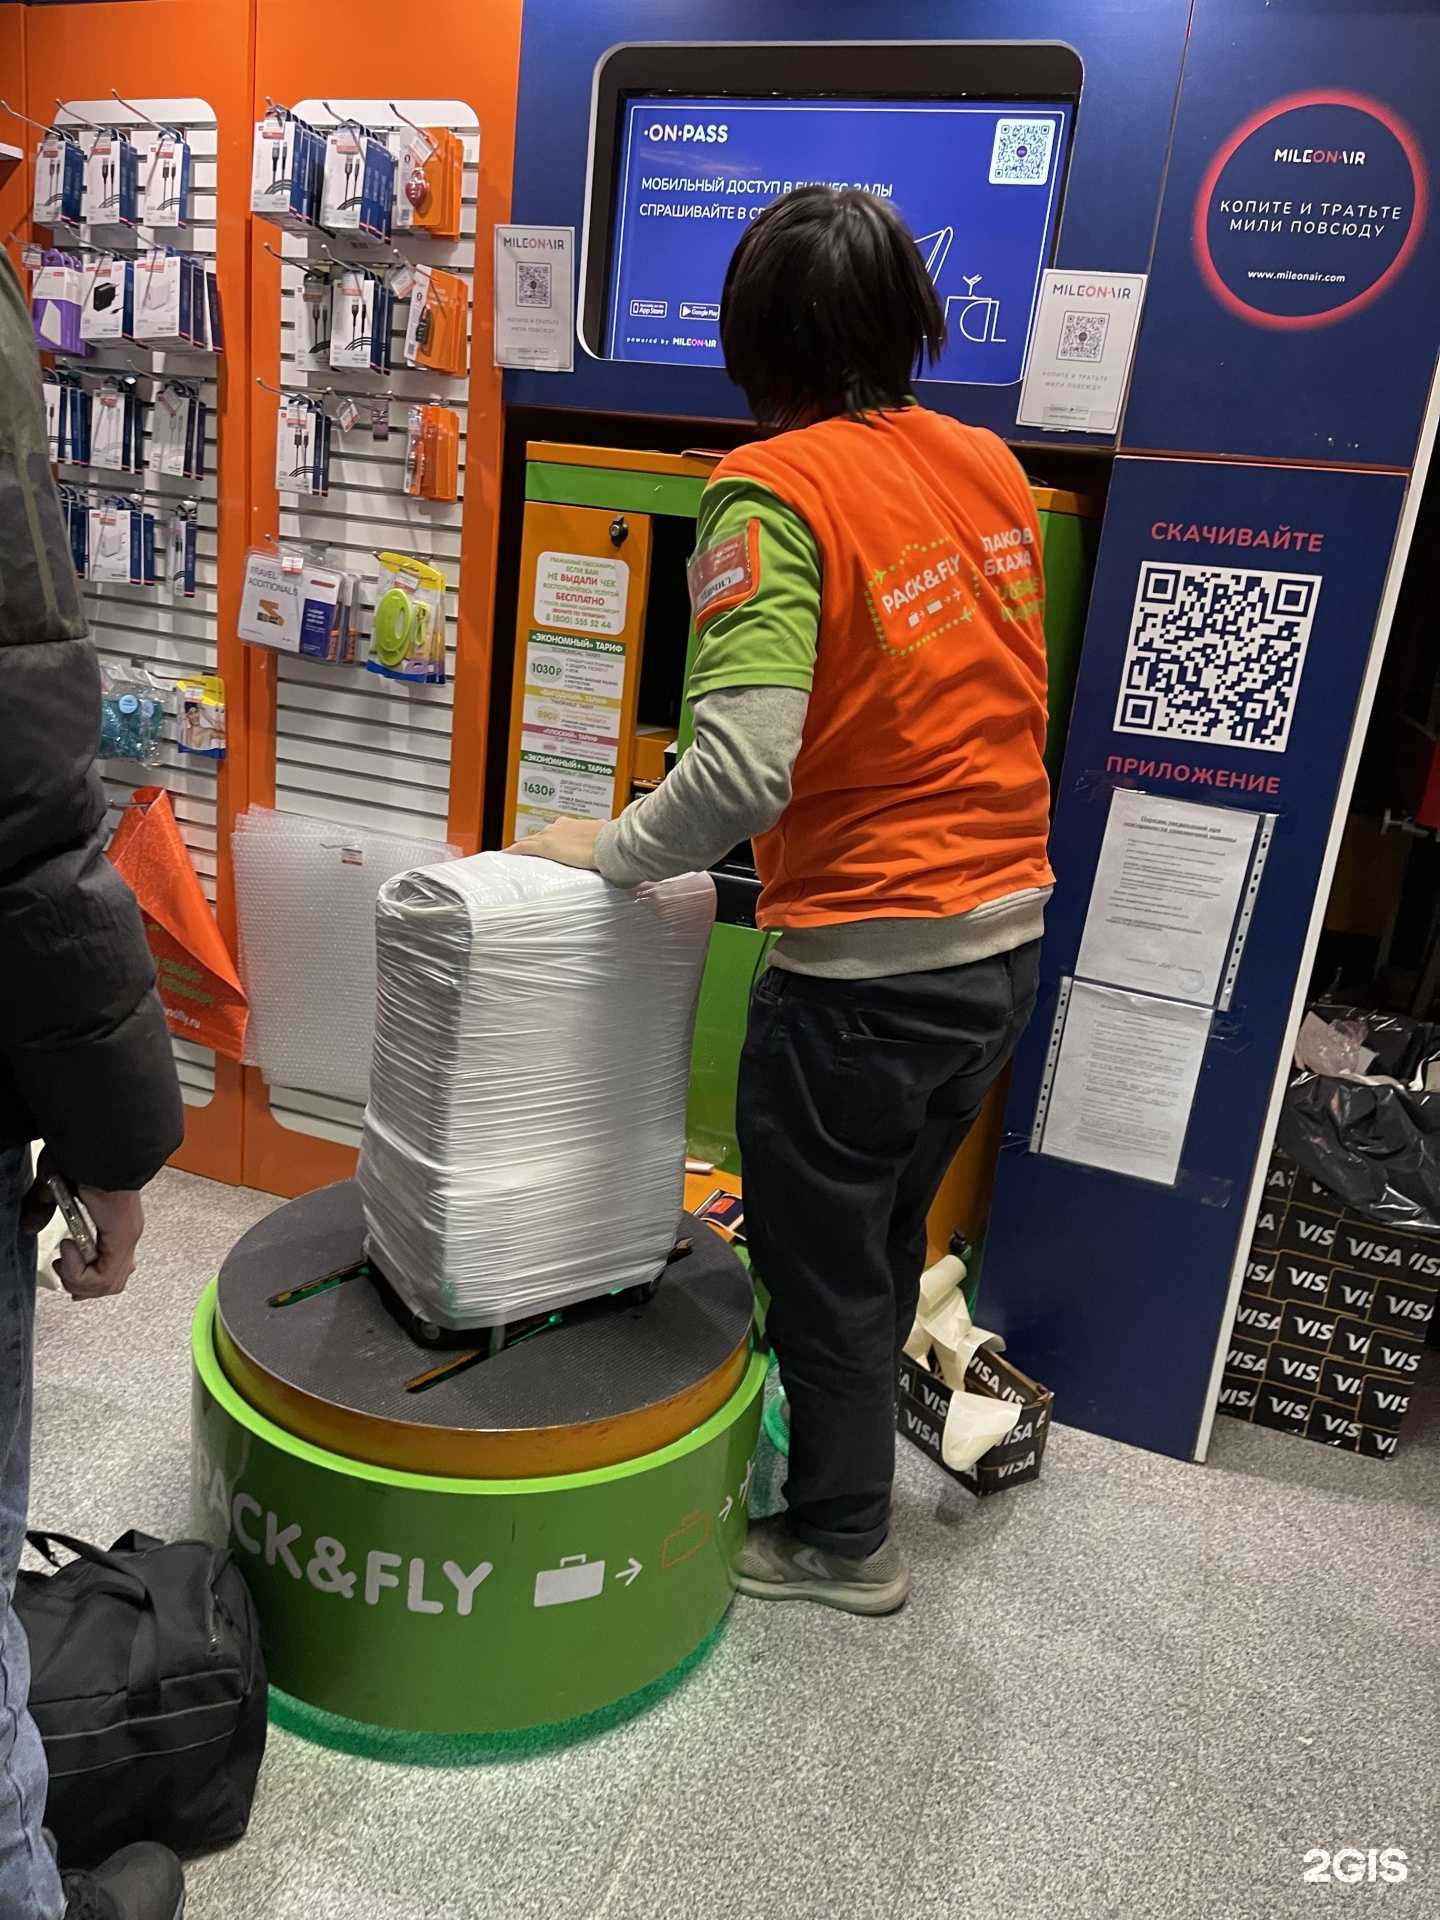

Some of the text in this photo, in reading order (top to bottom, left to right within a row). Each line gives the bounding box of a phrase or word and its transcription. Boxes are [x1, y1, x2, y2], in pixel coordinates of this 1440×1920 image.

[641, 176, 725, 192] МОБИЛЬНЫЙ
[726, 179, 780, 195] ДОСТУП
[783, 181, 792, 193] В
[639, 203, 735, 219] СПРАШИВАЙТЕ
[737, 207, 747, 219] В
[1220, 200, 1402, 220] КОПИТЕ И ТРАТЬТЕ
[1229, 219, 1385, 238] МИЛИ ПОВСЮДУ
[1248, 269, 1345, 283] www.mileonair.com
[1150, 522, 1325, 553] СКАЧИВАЙТЕ
[560, 573, 598, 586] ВЫДАЛИ
[881, 554, 961, 615] PACK&FLY
[555, 592, 605, 606] БЕСПЛАТНО
[595, 641, 623, 652] ТАРИФ
[588, 764, 613, 775] ТАРИФ
[1106, 755, 1281, 794] ПРИЛОЖЕНИЕ
[1296, 1219, 1336, 1247] VIS
[1346, 1237, 1401, 1266] VISA
[1287, 1266, 1328, 1293] VIS
[1293, 1316, 1335, 1340] VIS
[1280, 1356, 1320, 1382] VIS
[1381, 1346, 1421, 1371] VIS
[922, 1384, 949, 1417] VIS
[1268, 1395, 1309, 1421] VIS
[1373, 1390, 1411, 1413] VIS
[904, 1409, 940, 1451] VISA
[1321, 1413, 1363, 1438] VIS
